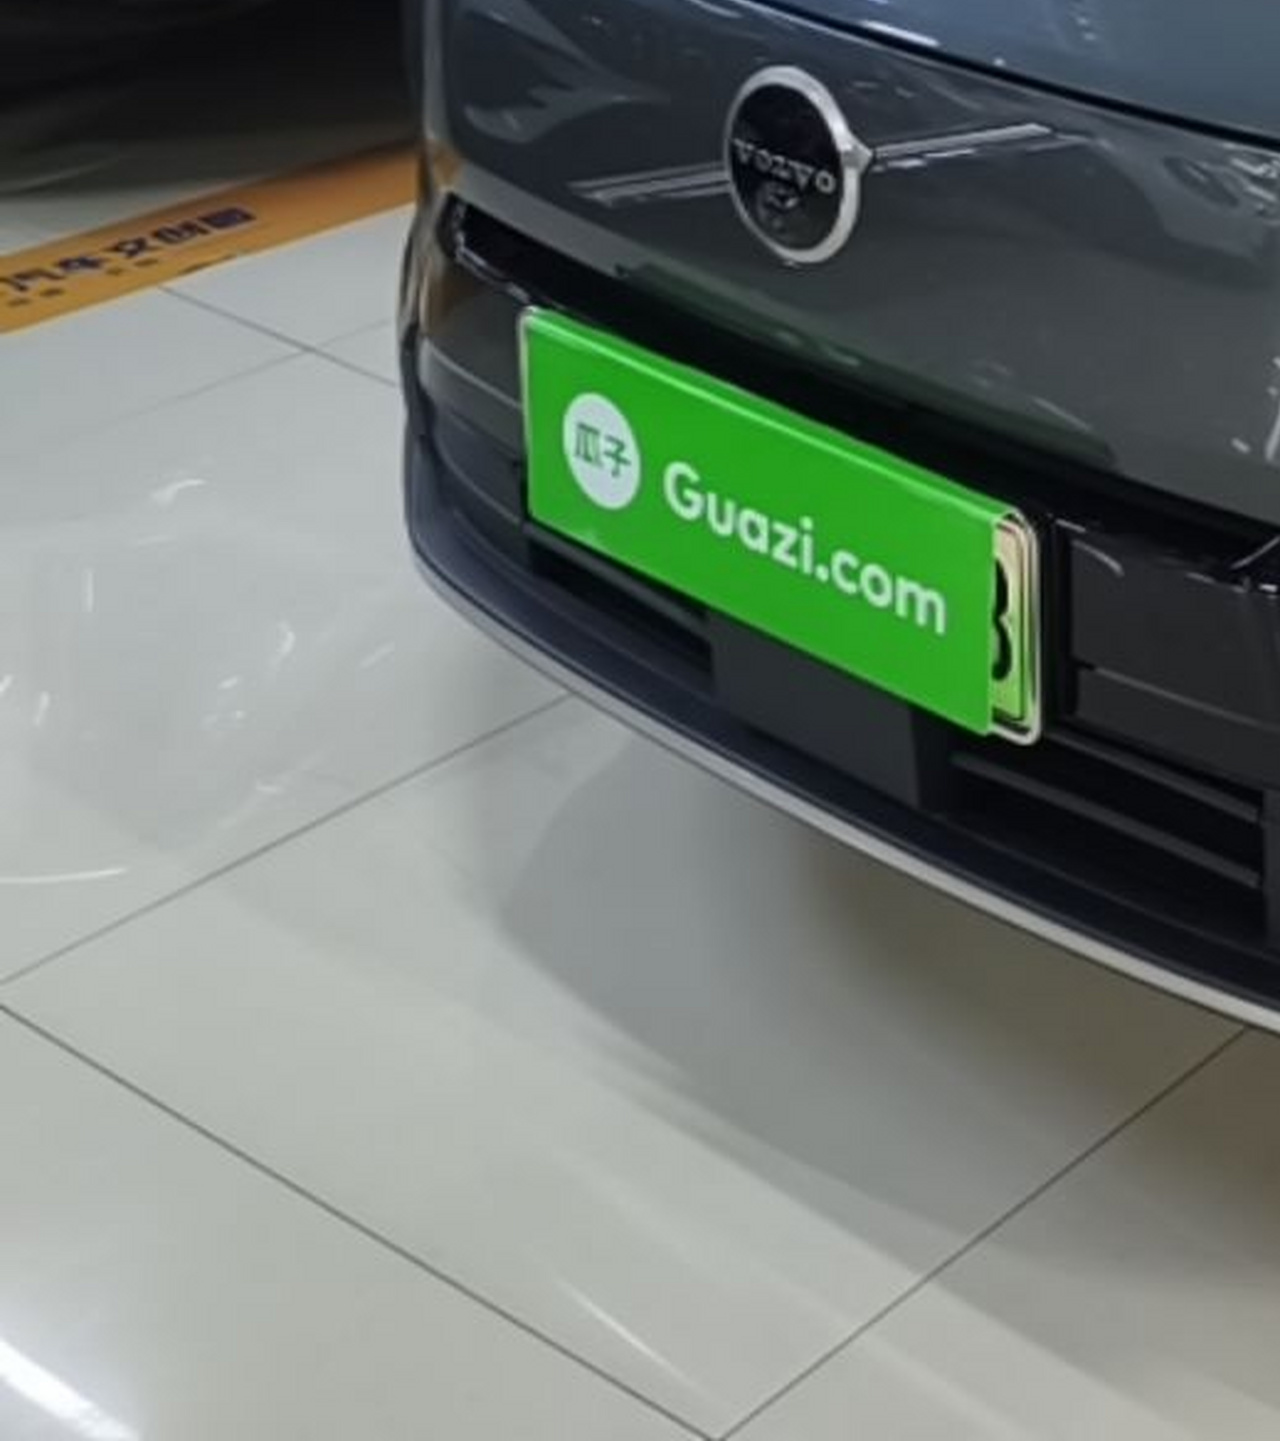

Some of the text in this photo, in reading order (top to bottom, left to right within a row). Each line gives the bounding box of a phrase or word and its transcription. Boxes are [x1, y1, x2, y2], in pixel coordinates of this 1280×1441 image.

[733, 138, 837, 195] VOLVO
[574, 421, 948, 637] 瓜子 Guazi.com
